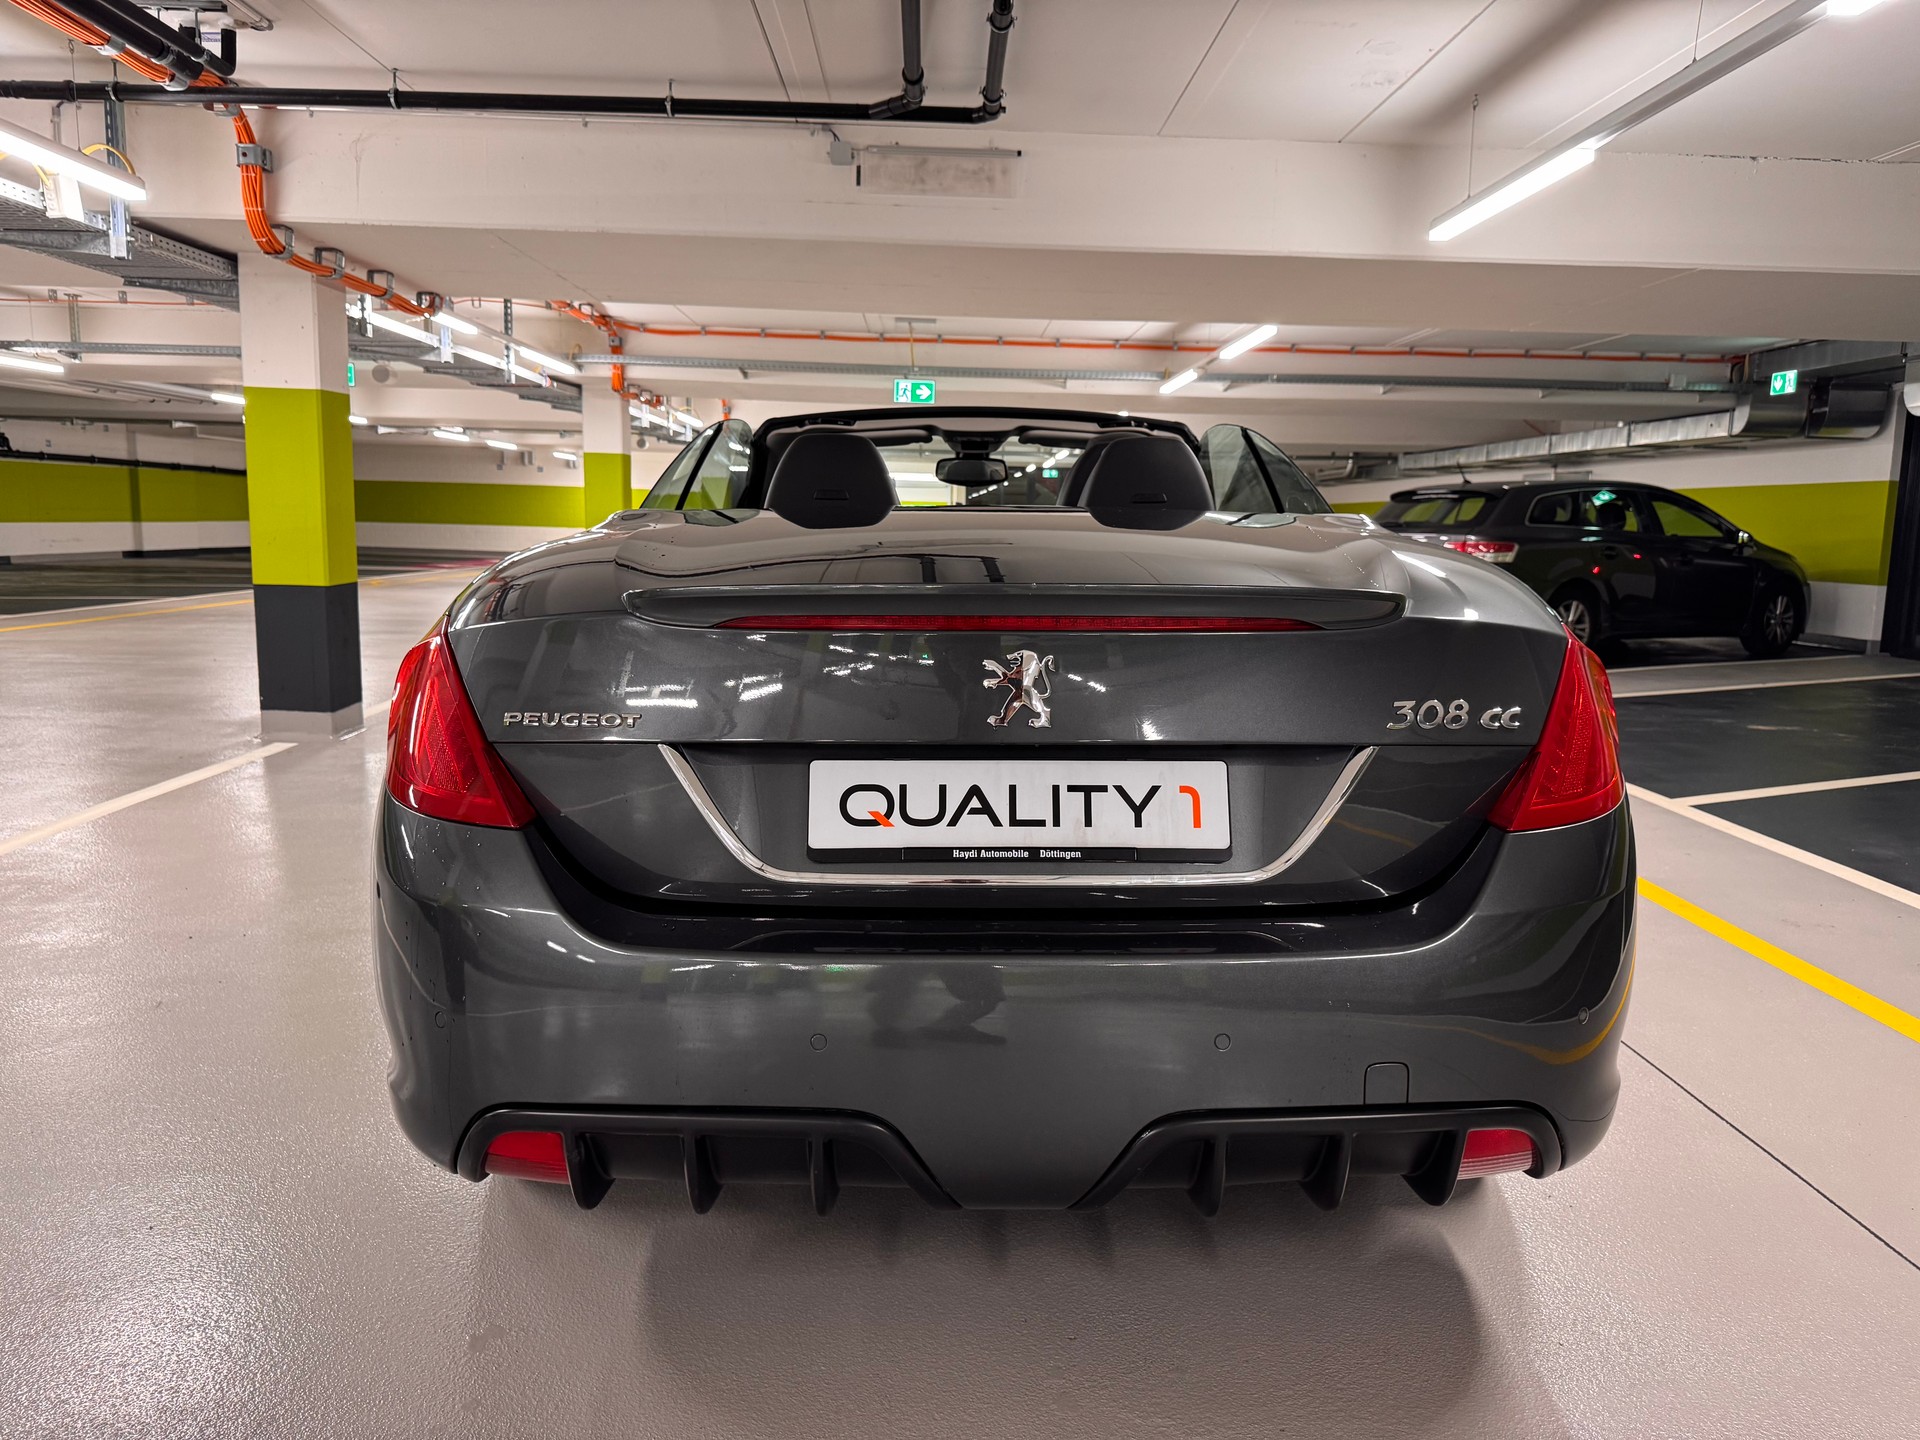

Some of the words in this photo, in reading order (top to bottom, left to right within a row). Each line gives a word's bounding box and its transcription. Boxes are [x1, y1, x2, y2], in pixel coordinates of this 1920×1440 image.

[503, 711, 642, 729] PEUGEOT
[1386, 698, 1470, 730] 308
[839, 784, 1162, 828] QUALITY
[1179, 785, 1202, 829] 1
[952, 849, 978, 860] Haydi
[980, 849, 1029, 859] Automobile
[1039, 849, 1082, 860] Döttingen
